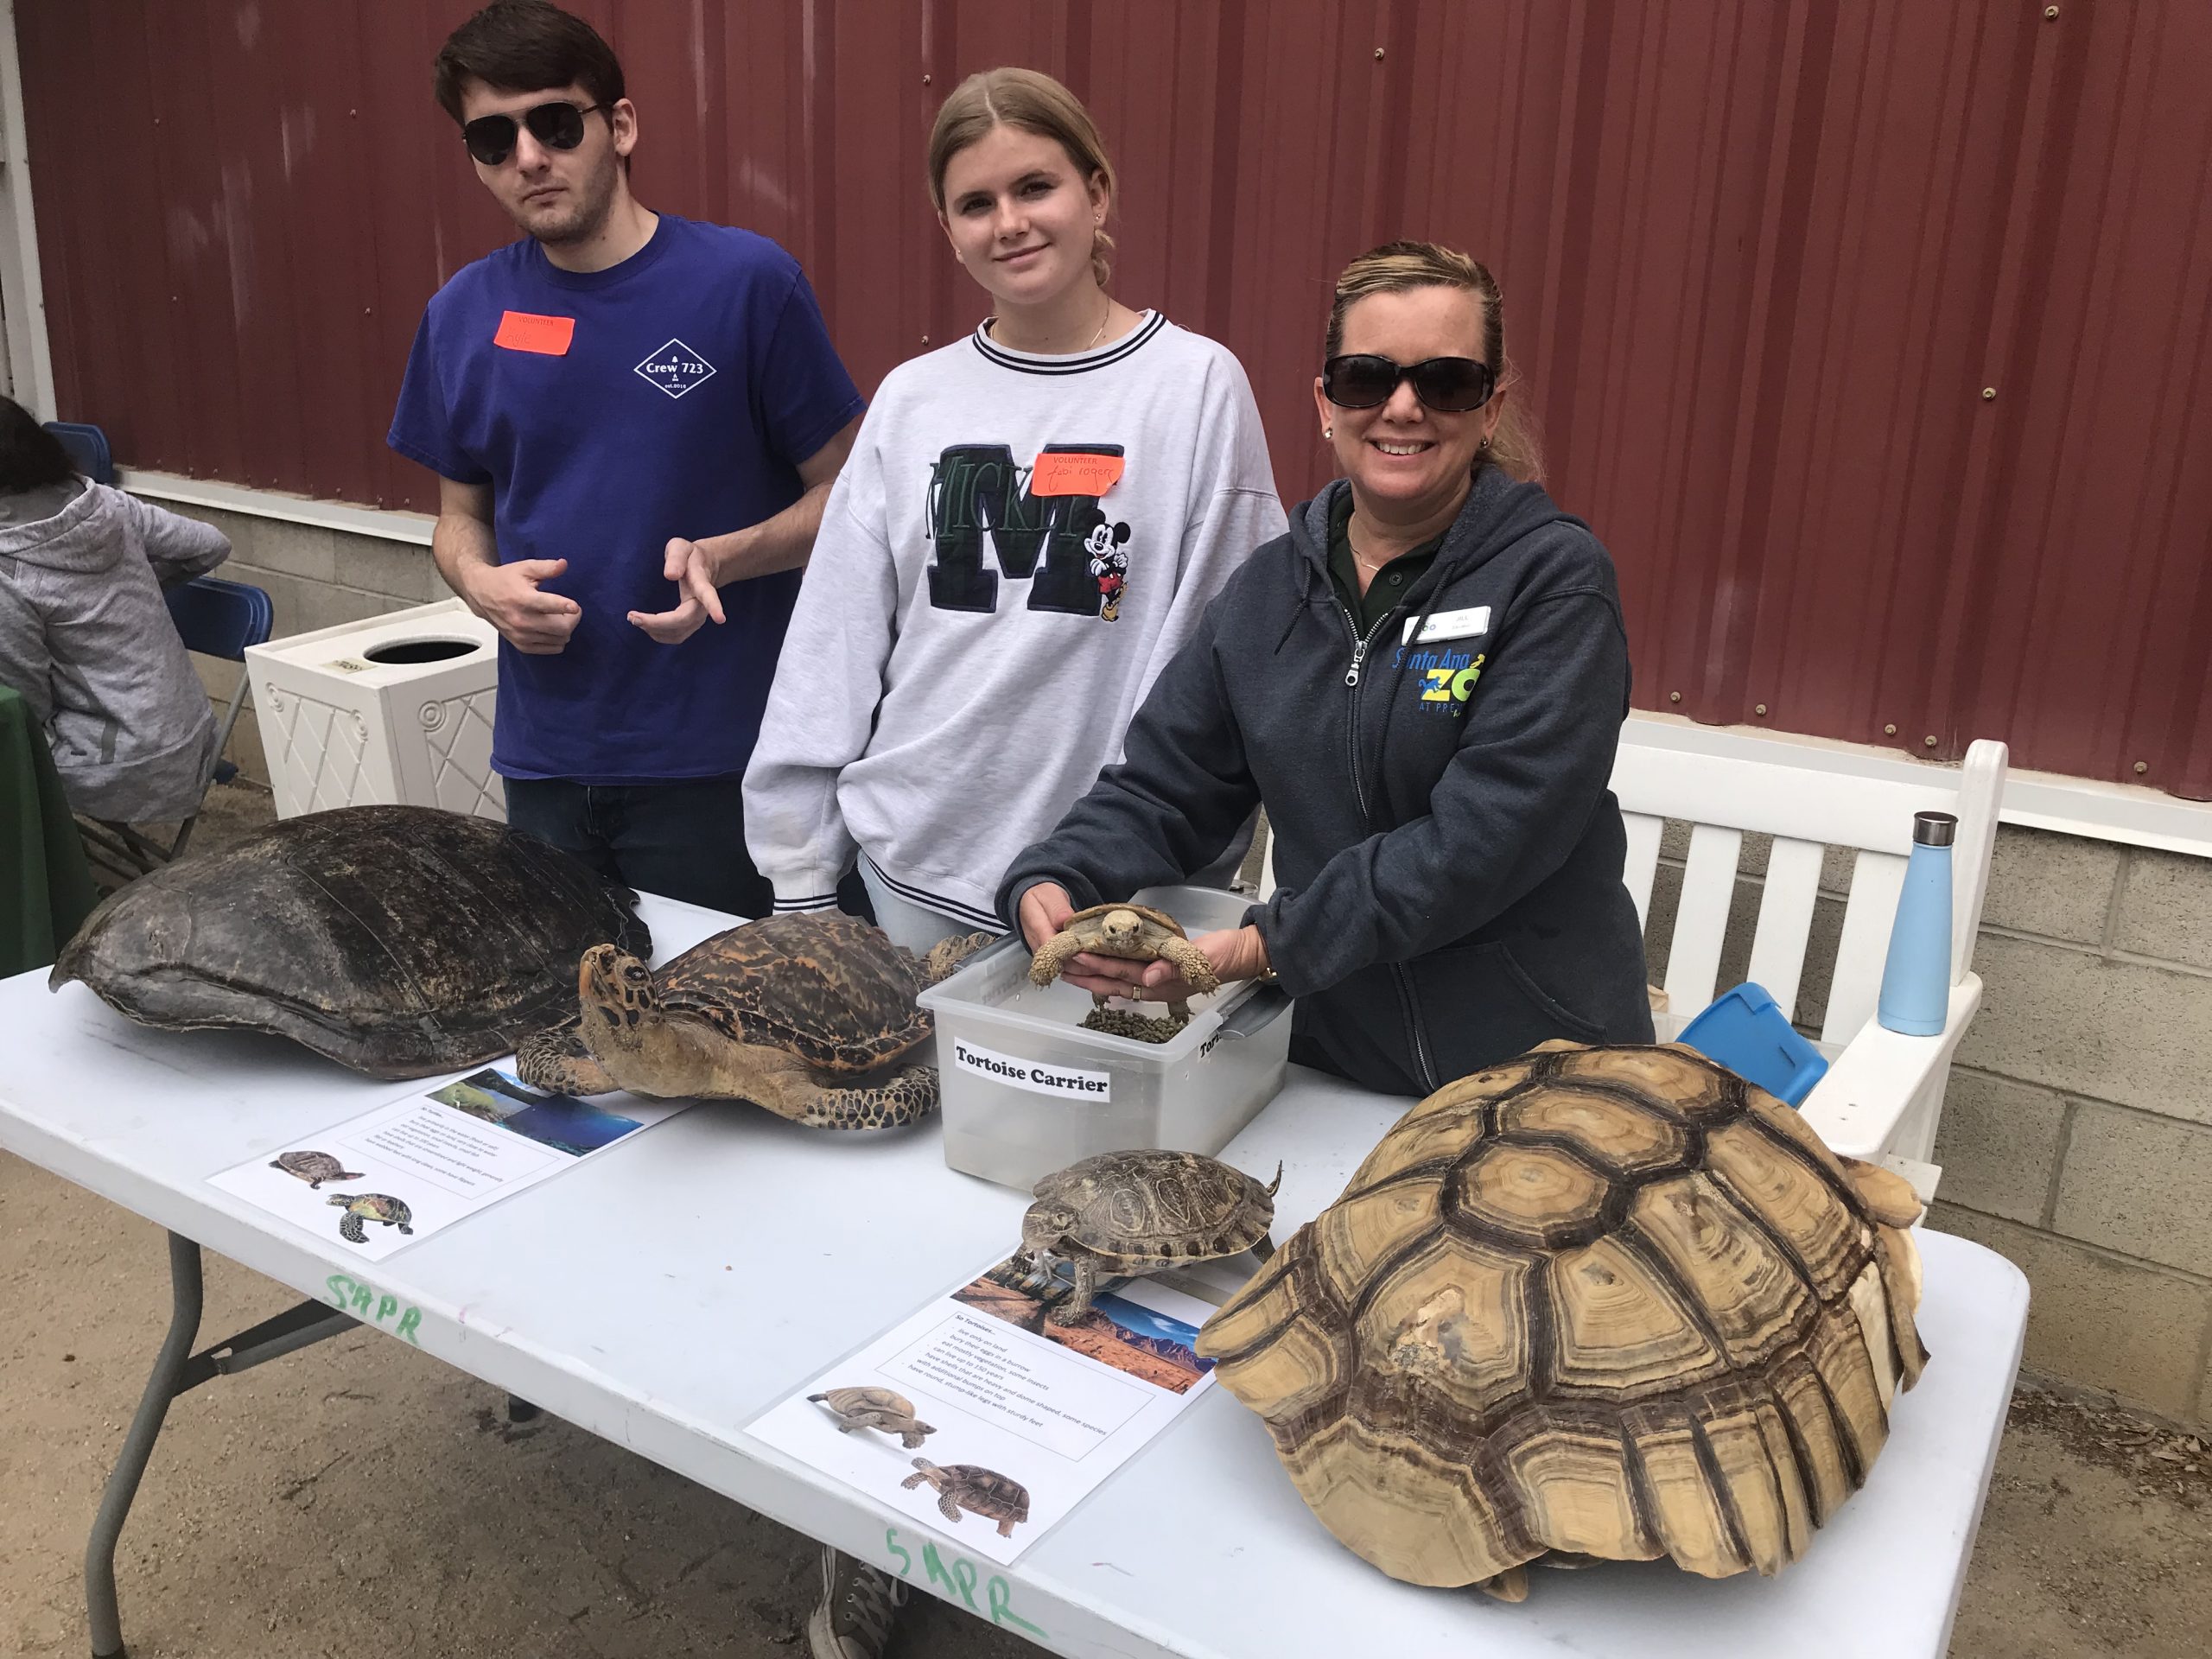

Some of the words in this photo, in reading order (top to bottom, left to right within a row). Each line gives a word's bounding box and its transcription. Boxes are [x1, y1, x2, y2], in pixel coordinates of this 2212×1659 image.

[518, 316, 554, 327] VOLUNTEER
[645, 362, 678, 373] Crew
[681, 362, 703, 374] 723
[1391, 646, 1437, 670] Snta
[1438, 648, 1471, 670] Ana
[1421, 668, 1481, 702] ZO
[1418, 702, 1431, 712] AT
[955, 1045, 1027, 1081] Tortoise
[1030, 1068, 1109, 1094] Carrier
[323, 1274, 423, 1347] SAPR
[950, 1334, 964, 1343] bury
[1007, 1360, 1030, 1371] burrow
[952, 1346, 973, 1357] mostly
[974, 1355, 1007, 1372] vegetation,
[1008, 1370, 1027, 1380] some
[1027, 1378, 1049, 1389] insects
[931, 1366, 963, 1381] additional
[962, 1379, 984, 1390] bumps
[986, 1370, 1004, 1380] years
[908, 1364, 923, 1373] have
[923, 1372, 944, 1383] round,
[944, 1382, 977, 1398] stump-like
[978, 1395, 991, 1404] legs
[992, 1402, 1007, 1411] with
[1007, 1409, 1028, 1421] sturdy
[1028, 1418, 1043, 1427] feet
[925, 1352, 940, 1361] have
[940, 1360, 958, 1370] shells
[983, 1378, 1003, 1389] heavy
[1016, 1394, 1035, 1403] dome
[1035, 1402, 1061, 1415] shaped,
[1062, 1414, 1081, 1423] some
[1081, 1422, 1107, 1434] species
[885, 1526, 1051, 1640] SAPR
